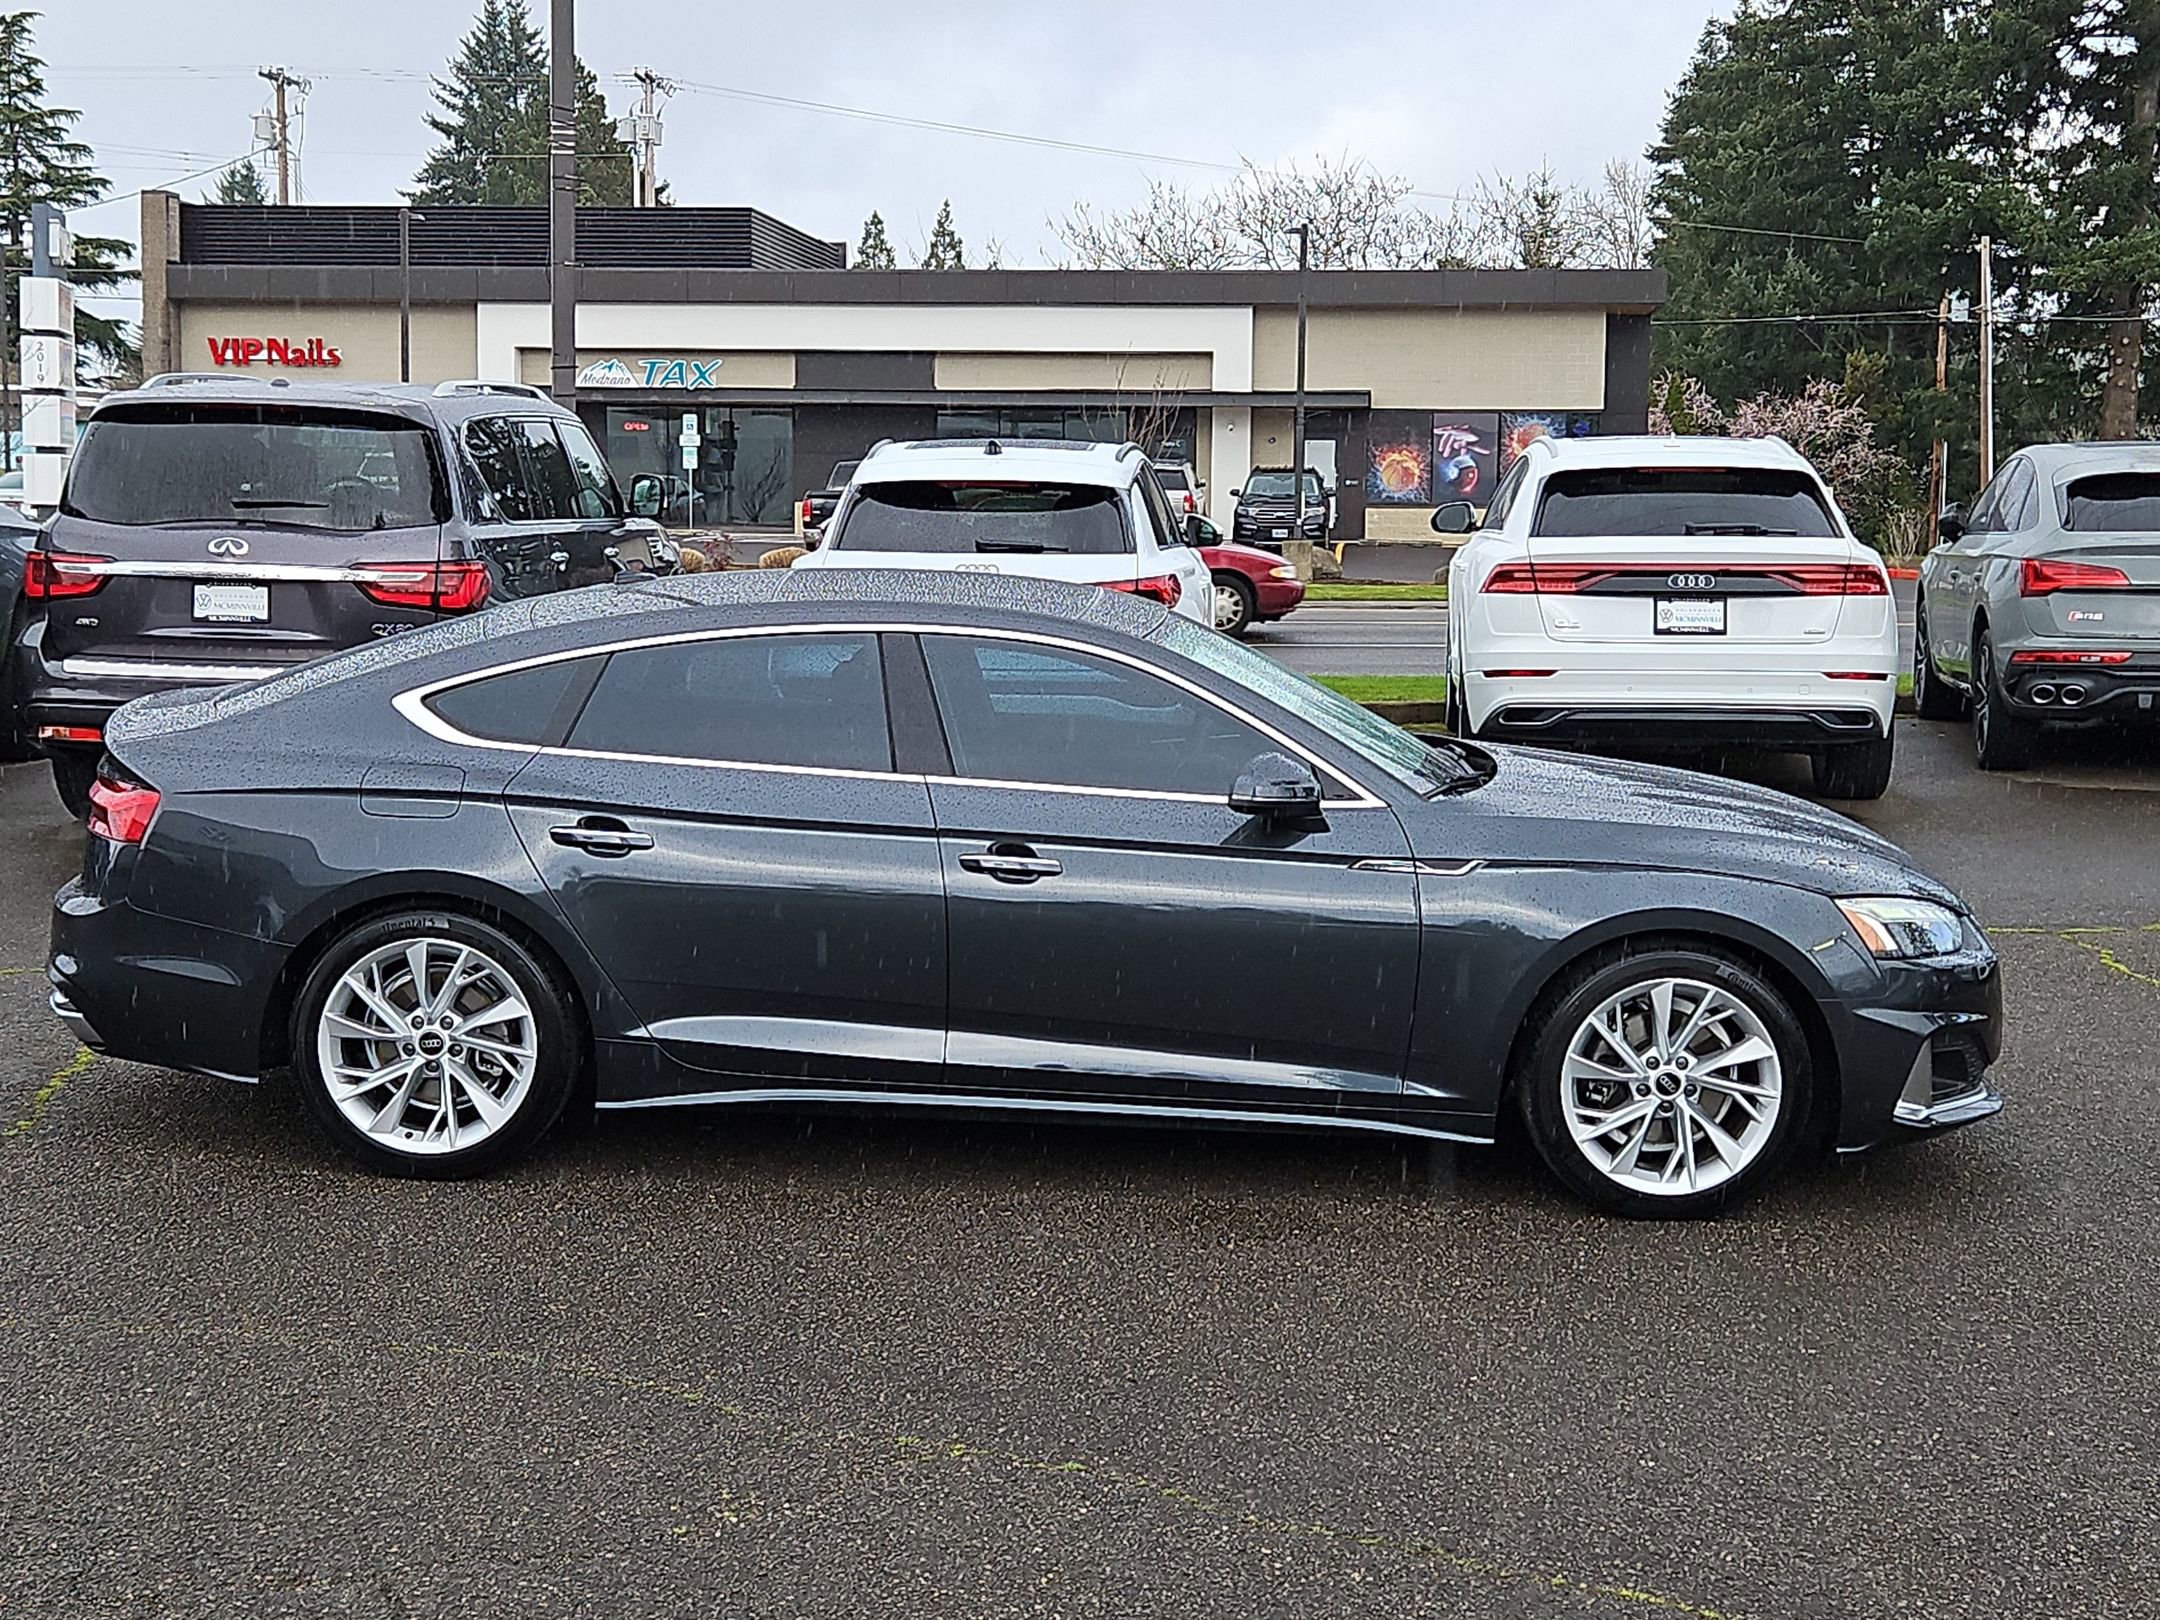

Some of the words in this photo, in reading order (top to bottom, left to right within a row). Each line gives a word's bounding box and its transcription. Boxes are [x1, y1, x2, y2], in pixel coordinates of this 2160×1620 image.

[36, 341, 45, 383] 2019
[207, 336, 263, 366] VIP
[266, 337, 342, 367] Nails
[638, 359, 723, 390] TAX
